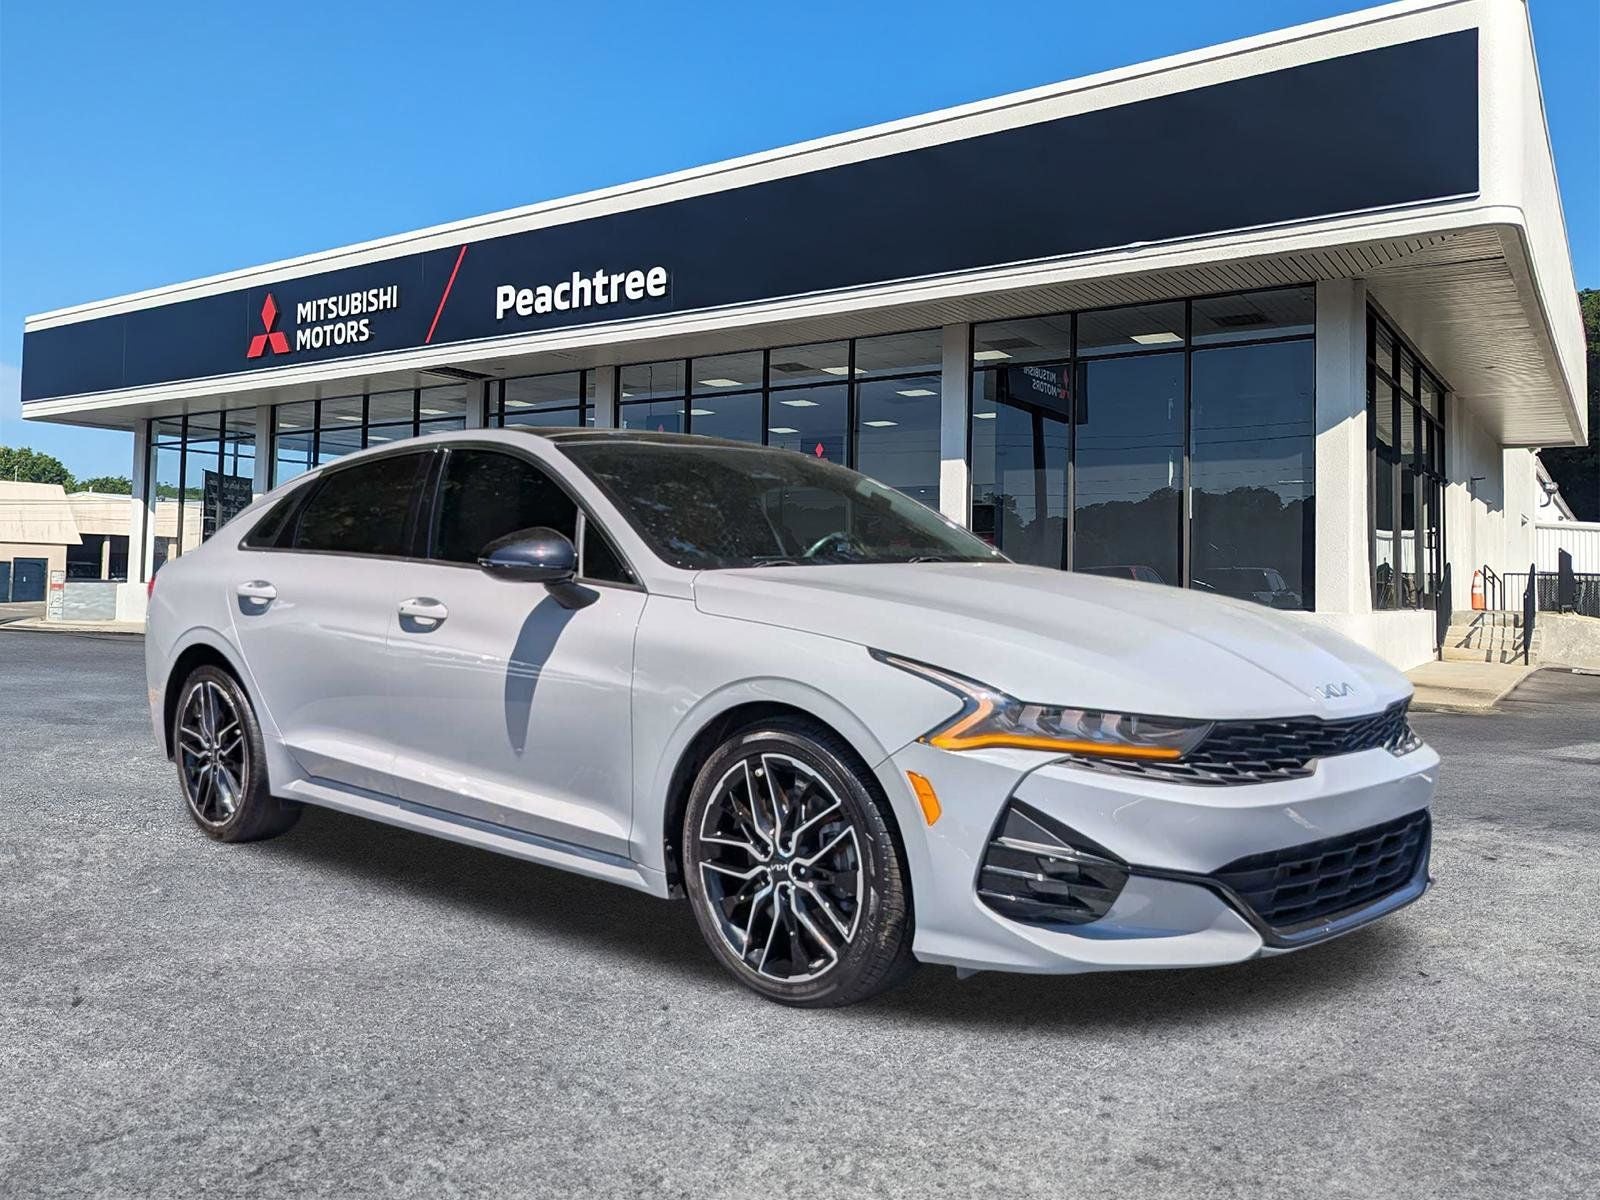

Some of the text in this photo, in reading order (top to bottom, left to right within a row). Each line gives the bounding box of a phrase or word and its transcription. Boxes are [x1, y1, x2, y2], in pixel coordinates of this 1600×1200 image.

[297, 285, 398, 324] MITSUBISHI
[496, 266, 667, 319] Peachtree
[296, 318, 369, 351] MOTORS
